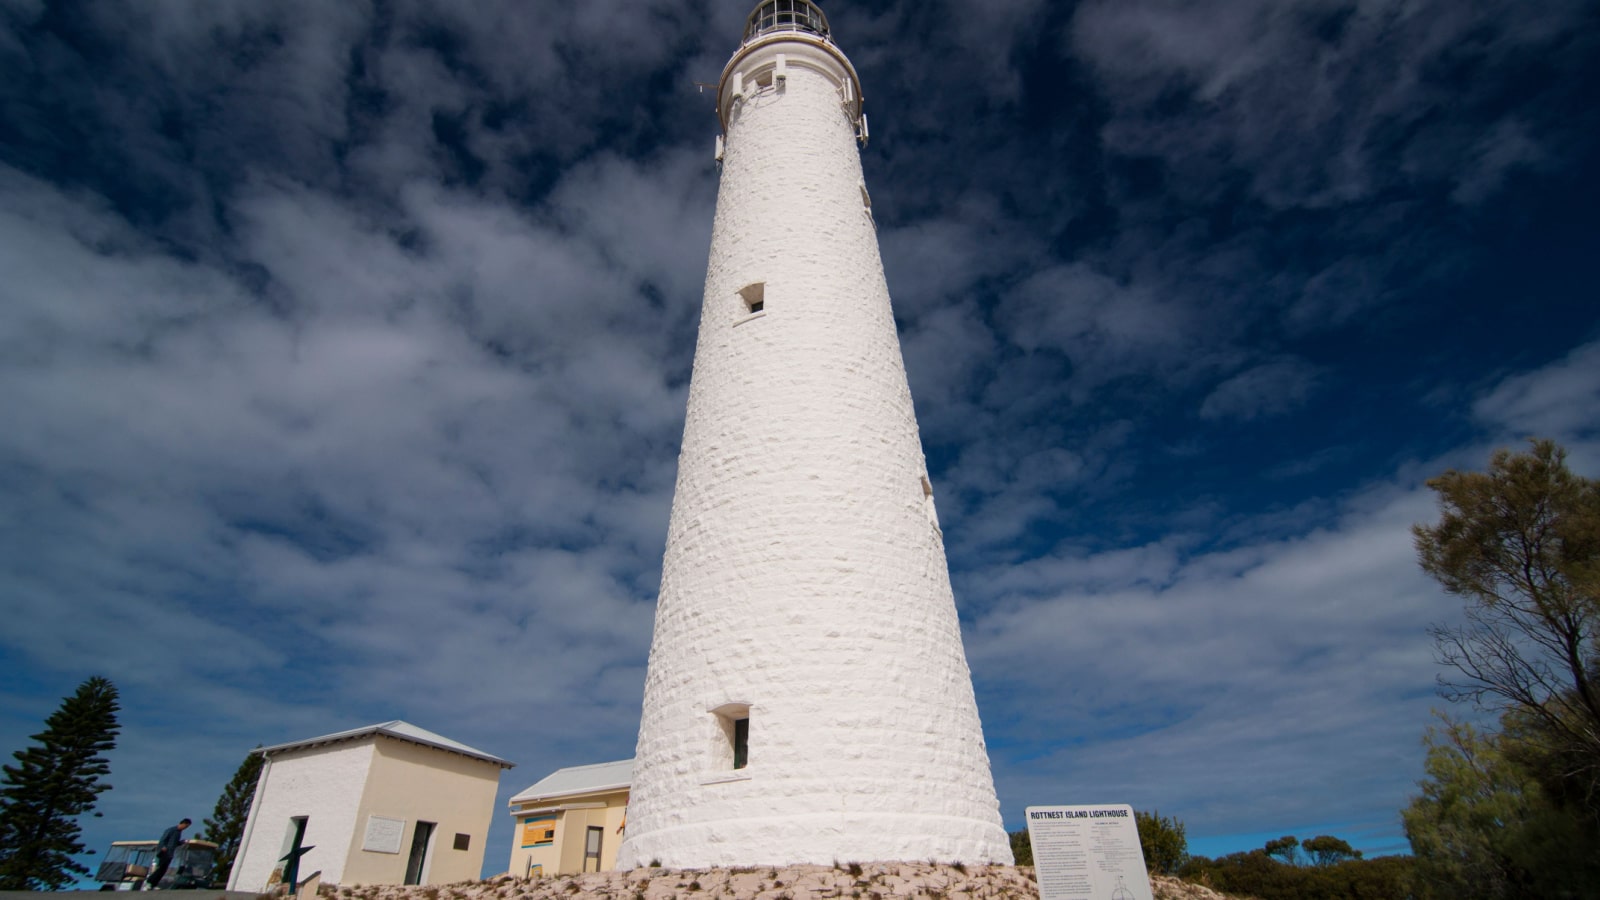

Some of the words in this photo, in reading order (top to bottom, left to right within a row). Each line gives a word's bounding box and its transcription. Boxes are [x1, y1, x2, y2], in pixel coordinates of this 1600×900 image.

[1030, 811, 1064, 820] ROTTNEST
[1066, 810, 1088, 818] ISLAND
[1089, 810, 1128, 818] LIGHTHOUSE
